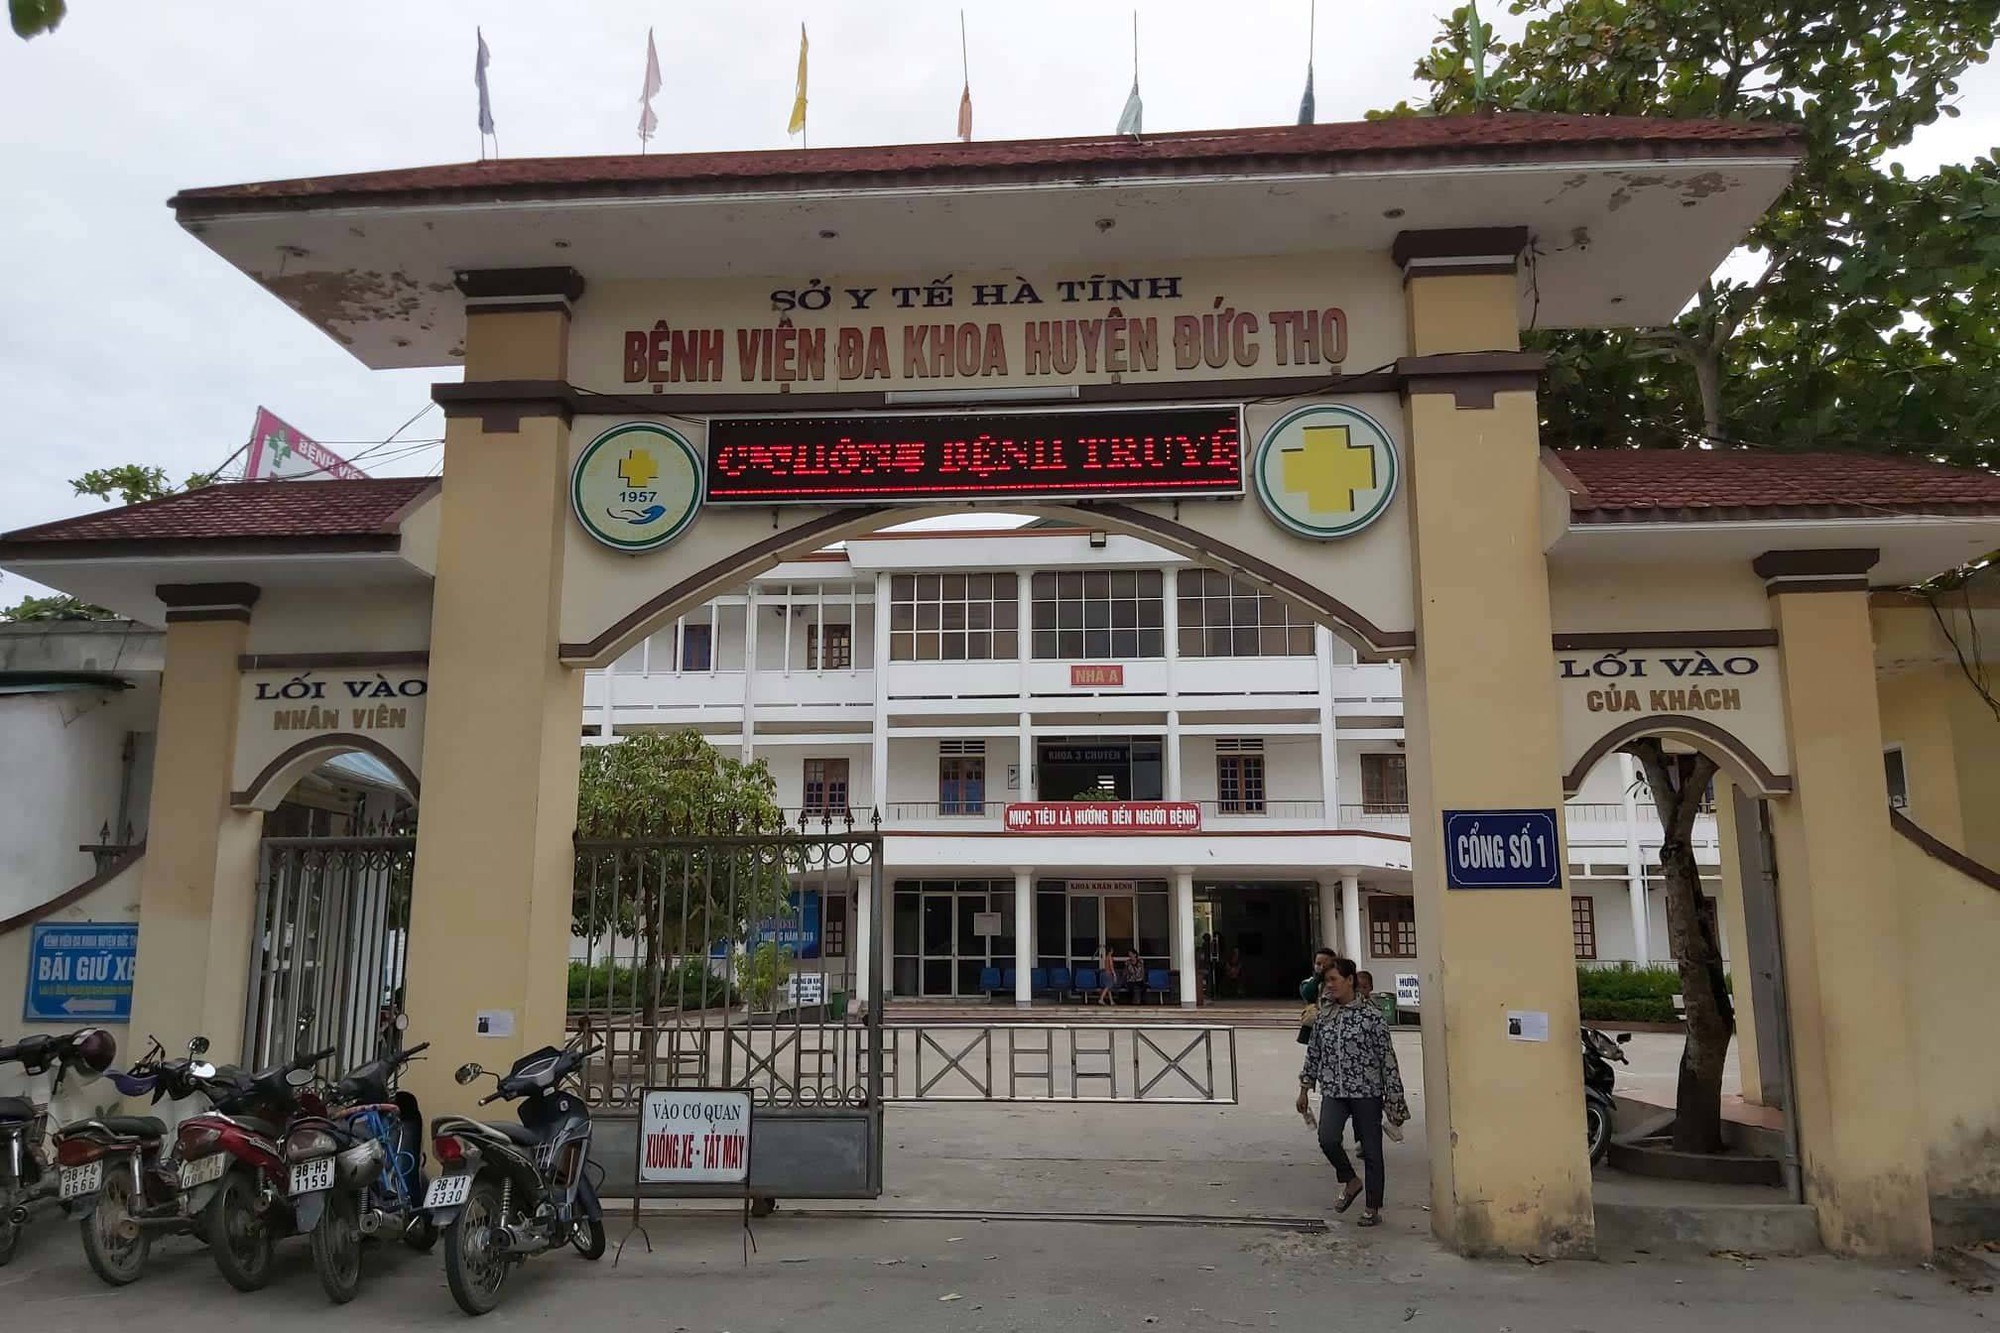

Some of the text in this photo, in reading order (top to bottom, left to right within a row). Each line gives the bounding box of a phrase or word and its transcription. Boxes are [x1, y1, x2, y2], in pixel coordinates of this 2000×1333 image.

[770, 274, 1183, 310] SỞ Y TẾ HÀ TĨNH
[624, 296, 1348, 394] BỆNH VIỆN ĐA KHOA HUYỆN ĐỨC THỌ
[619, 491, 658, 503] 1957
[1109, 669, 1119, 683] A
[1559, 649, 1759, 678] LỐI VÀO
[255, 672, 428, 700] LỐI VÀO
[1586, 683, 1742, 712] CỦA KHÁCH
[273, 704, 407, 731] NHÂN VIÊN
[1009, 804, 1197, 828] MỤC TIÊU LÀ HƯỚNG ĐẾN NGƯỜI BỆNH
[1458, 821, 1546, 868] CỔNG SỐ 1
[38, 952, 71, 981] BÃI
[76, 950, 113, 981] GIỮ
[653, 1099, 741, 1123] VÀO CƠ QUAN
[645, 1123, 679, 1169] XUỐNG
[703, 1123, 721, 1169] TẮT
[723, 1128, 745, 1169] MÁY
[295, 1160, 329, 1179] 38-H3
[64, 1177, 95, 1196] 8666
[295, 1174, 328, 1191] 1159
[434, 1176, 466, 1192] 38-V1
[430, 1190, 463, 1206] 3330
